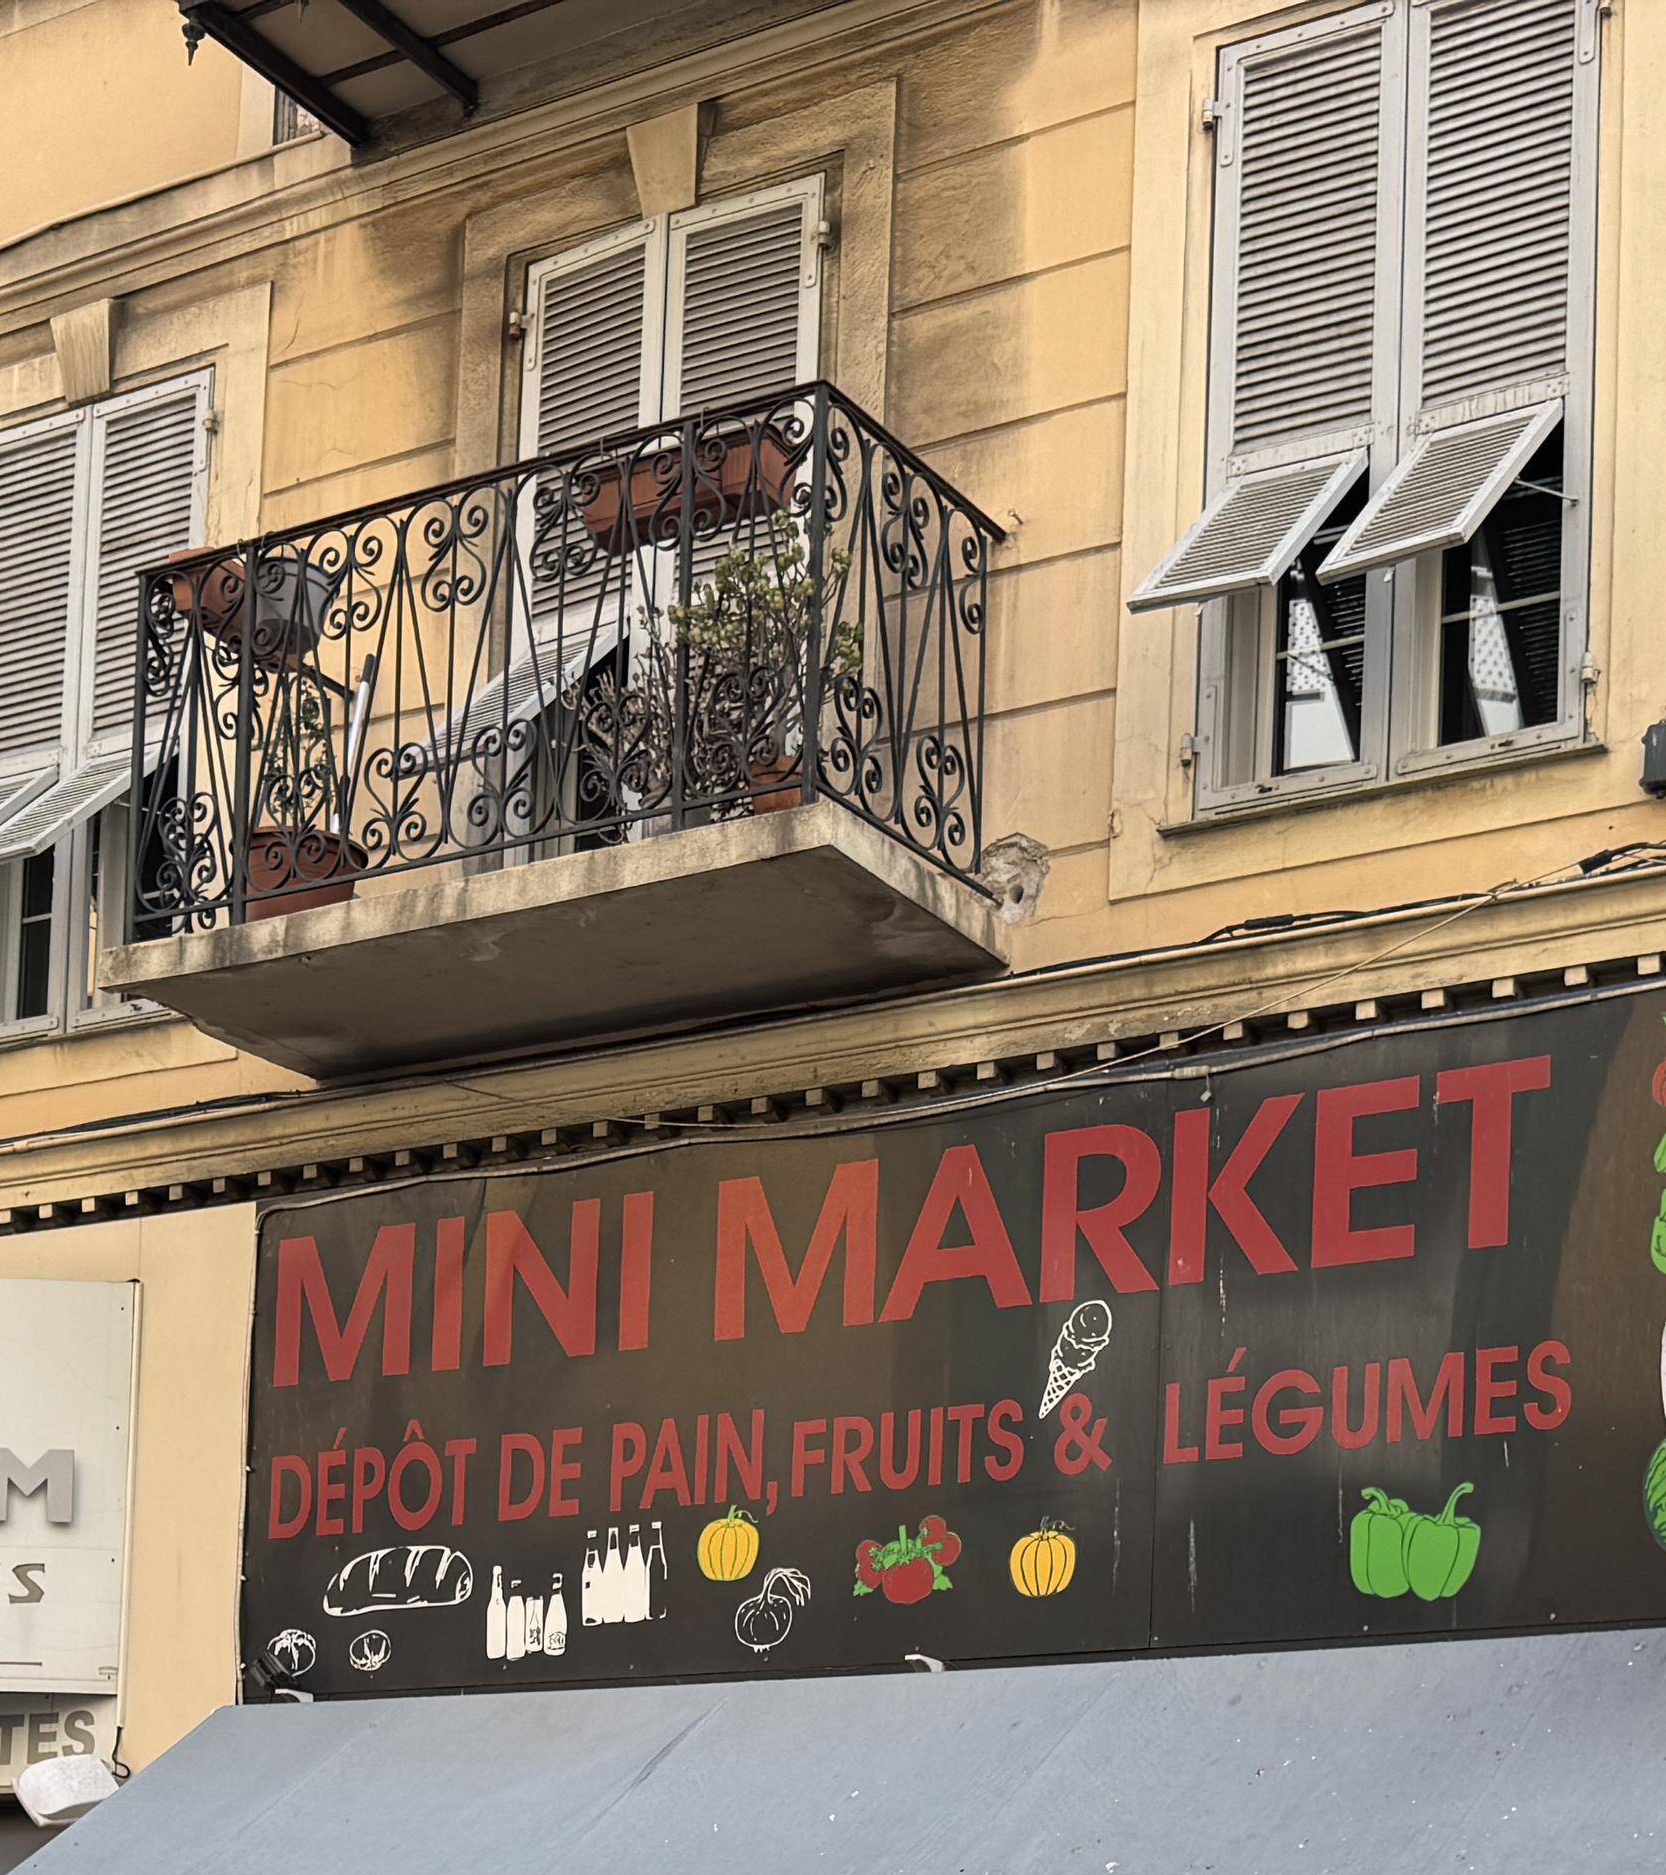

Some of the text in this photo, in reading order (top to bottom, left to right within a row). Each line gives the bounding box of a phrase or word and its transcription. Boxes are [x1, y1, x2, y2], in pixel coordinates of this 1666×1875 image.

[272, 1053, 1552, 1388] MINI MARKET
[267, 1419, 478, 1541] DÉPÔT
[497, 1427, 583, 1522] DE
[1053, 1392, 1112, 1477] &
[1164, 1340, 1573, 1465] LÉGUMES
